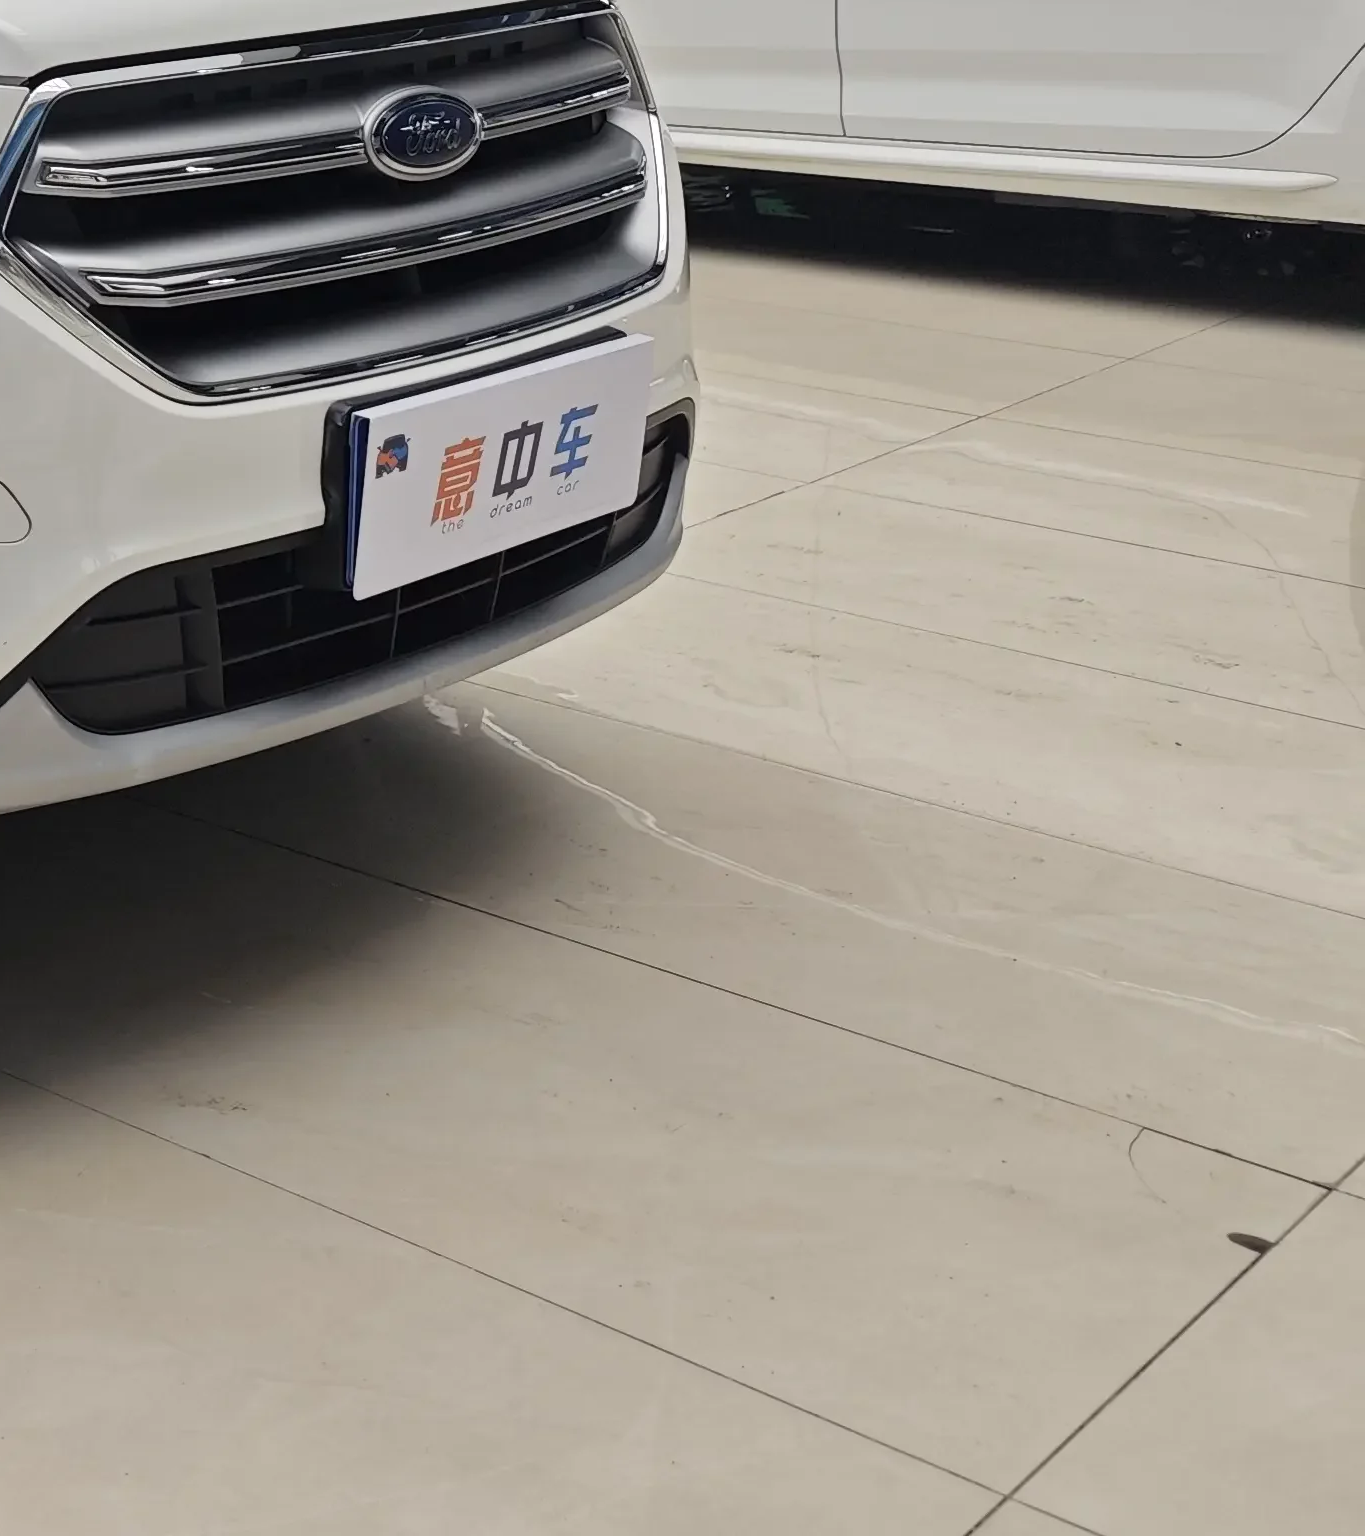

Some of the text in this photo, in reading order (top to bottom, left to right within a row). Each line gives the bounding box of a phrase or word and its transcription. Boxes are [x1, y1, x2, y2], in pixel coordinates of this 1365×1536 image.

[399, 111, 462, 156] Ford
[429, 403, 599, 528] 意中车
[440, 479, 580, 535] the dream car
